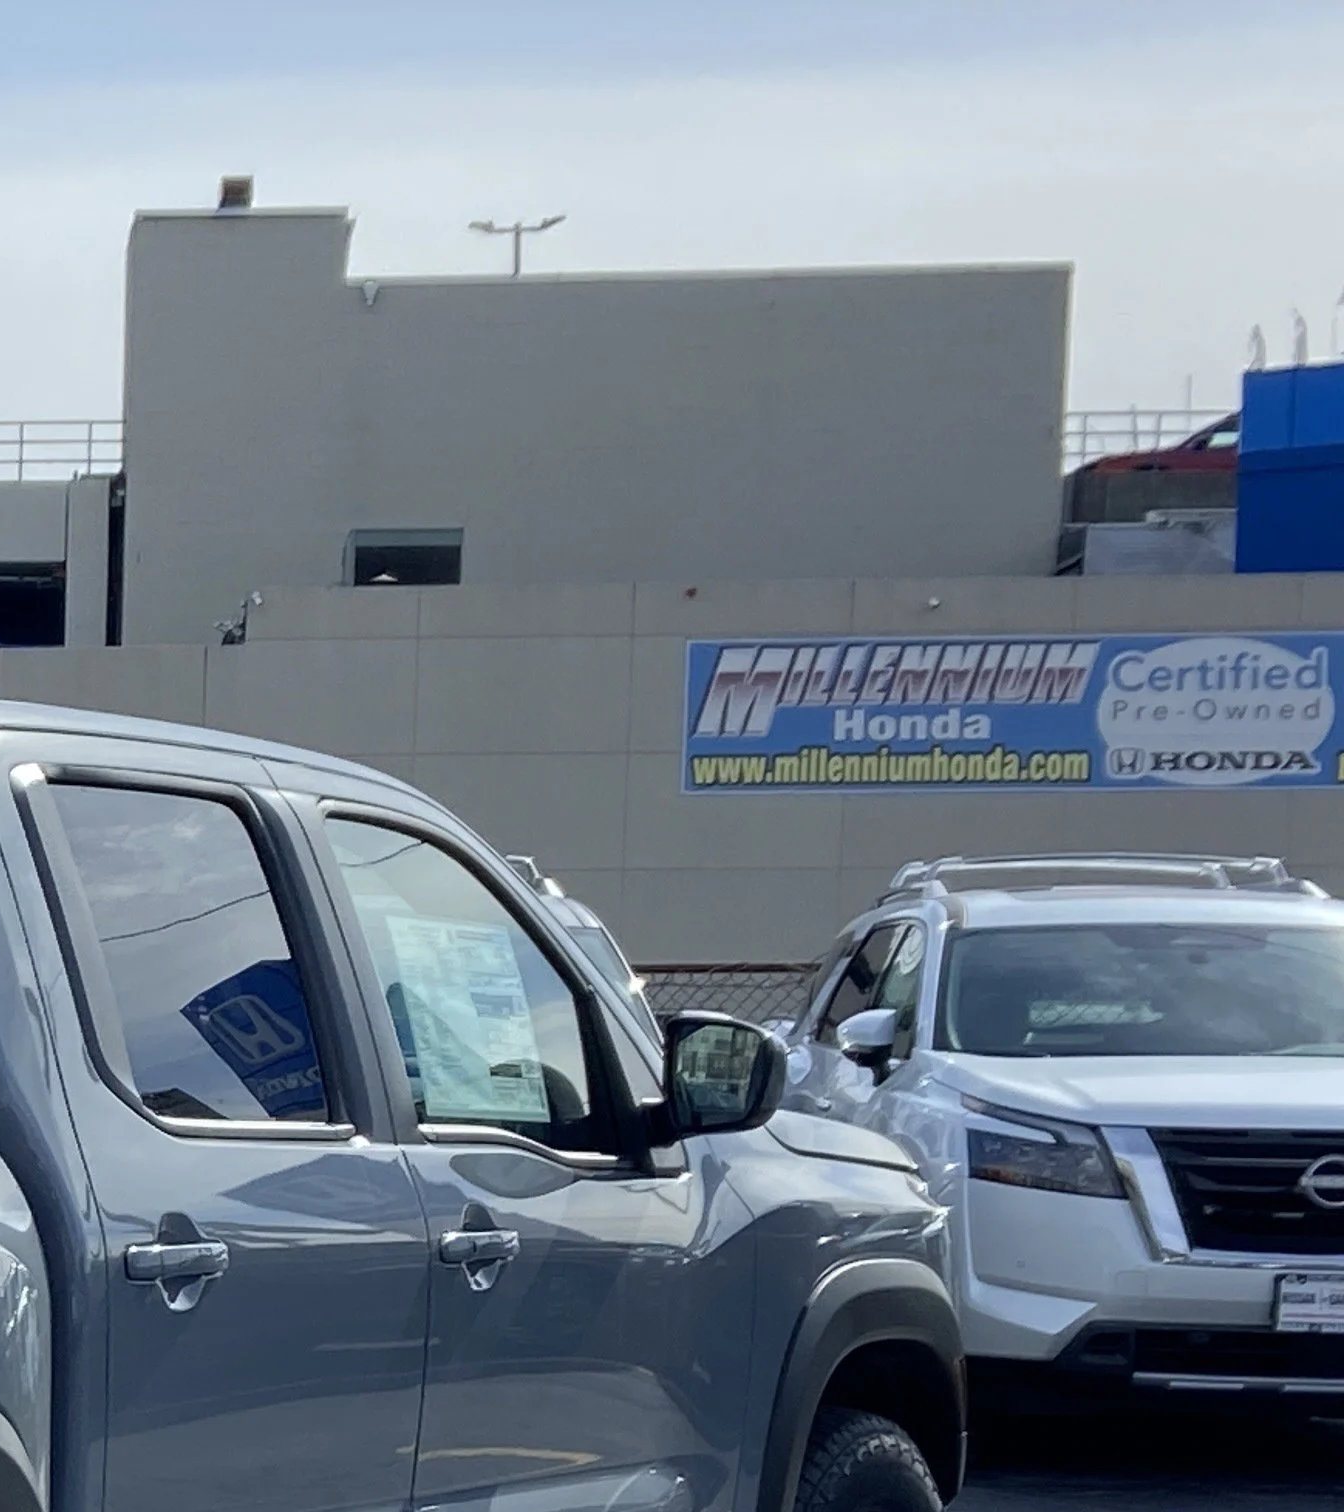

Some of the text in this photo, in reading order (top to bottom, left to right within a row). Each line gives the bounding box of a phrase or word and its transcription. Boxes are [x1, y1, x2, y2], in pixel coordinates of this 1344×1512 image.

[692, 641, 1100, 738] MILLENNIUM
[1112, 651, 1324, 692] Certified
[833, 708, 992, 741] Honda
[1112, 698, 1322, 721] Pre-Owned
[693, 745, 1091, 785] www.millenniumhonda.com
[1150, 750, 1315, 771] HONDA
